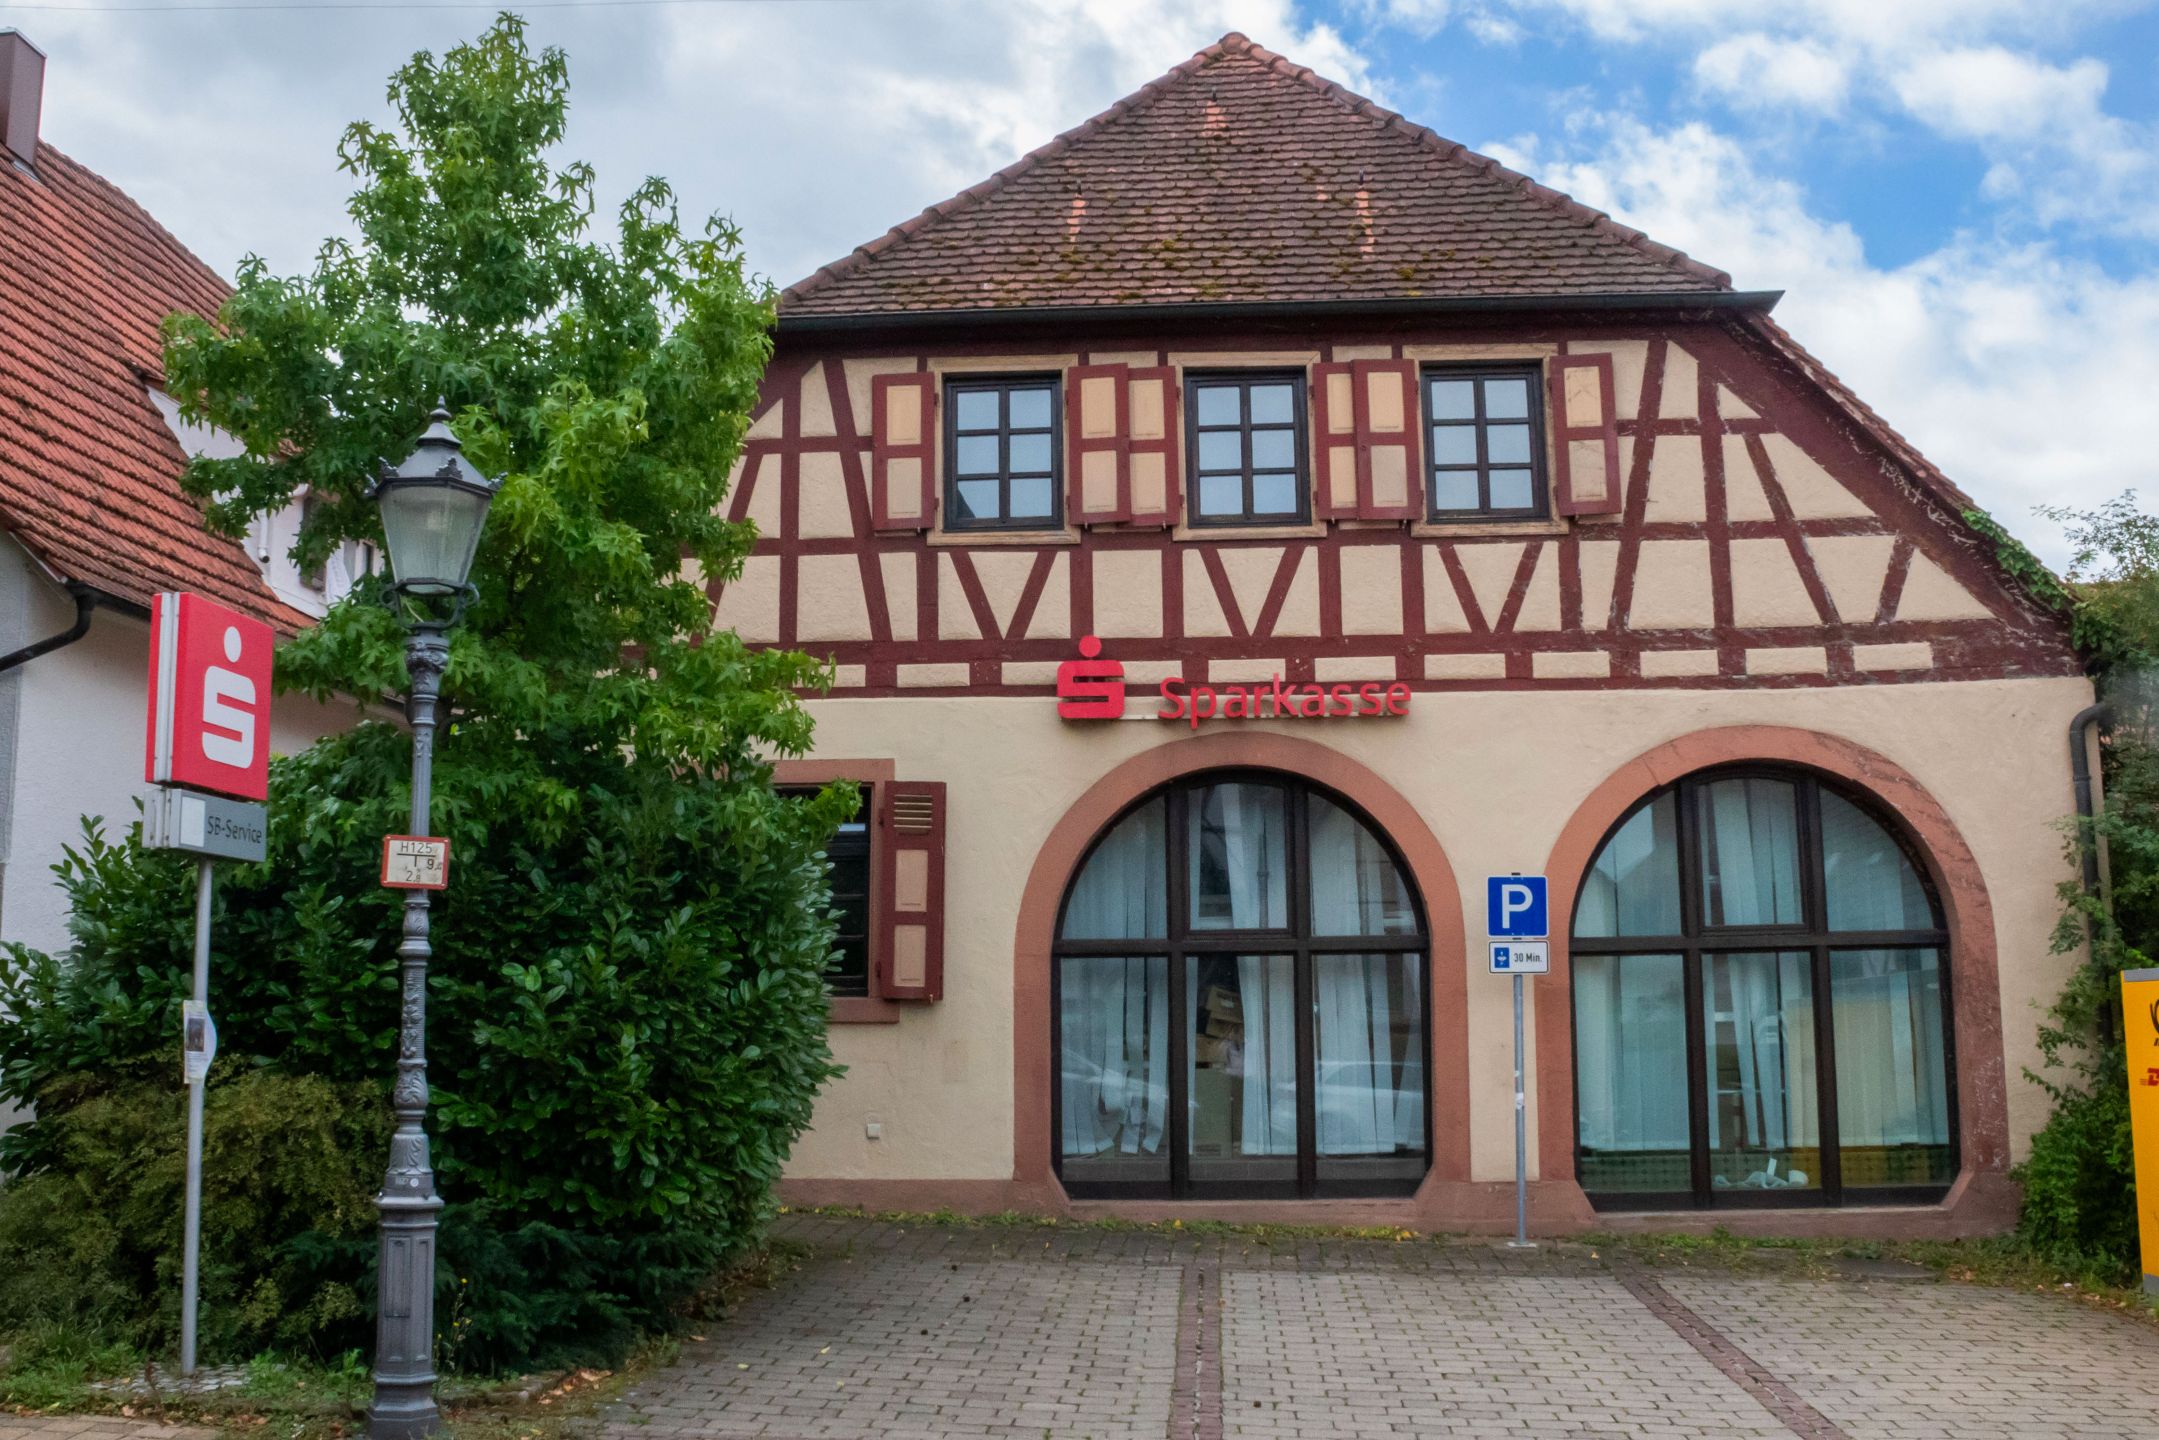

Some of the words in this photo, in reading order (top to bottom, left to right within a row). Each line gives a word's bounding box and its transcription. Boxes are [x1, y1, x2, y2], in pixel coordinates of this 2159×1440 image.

[1158, 672, 1412, 730] Sparkasse
[207, 815, 262, 844] SB-Service
[1501, 883, 1533, 929] P
[1513, 953, 1524, 963] 30
[1525, 953, 1543, 963] Min.
